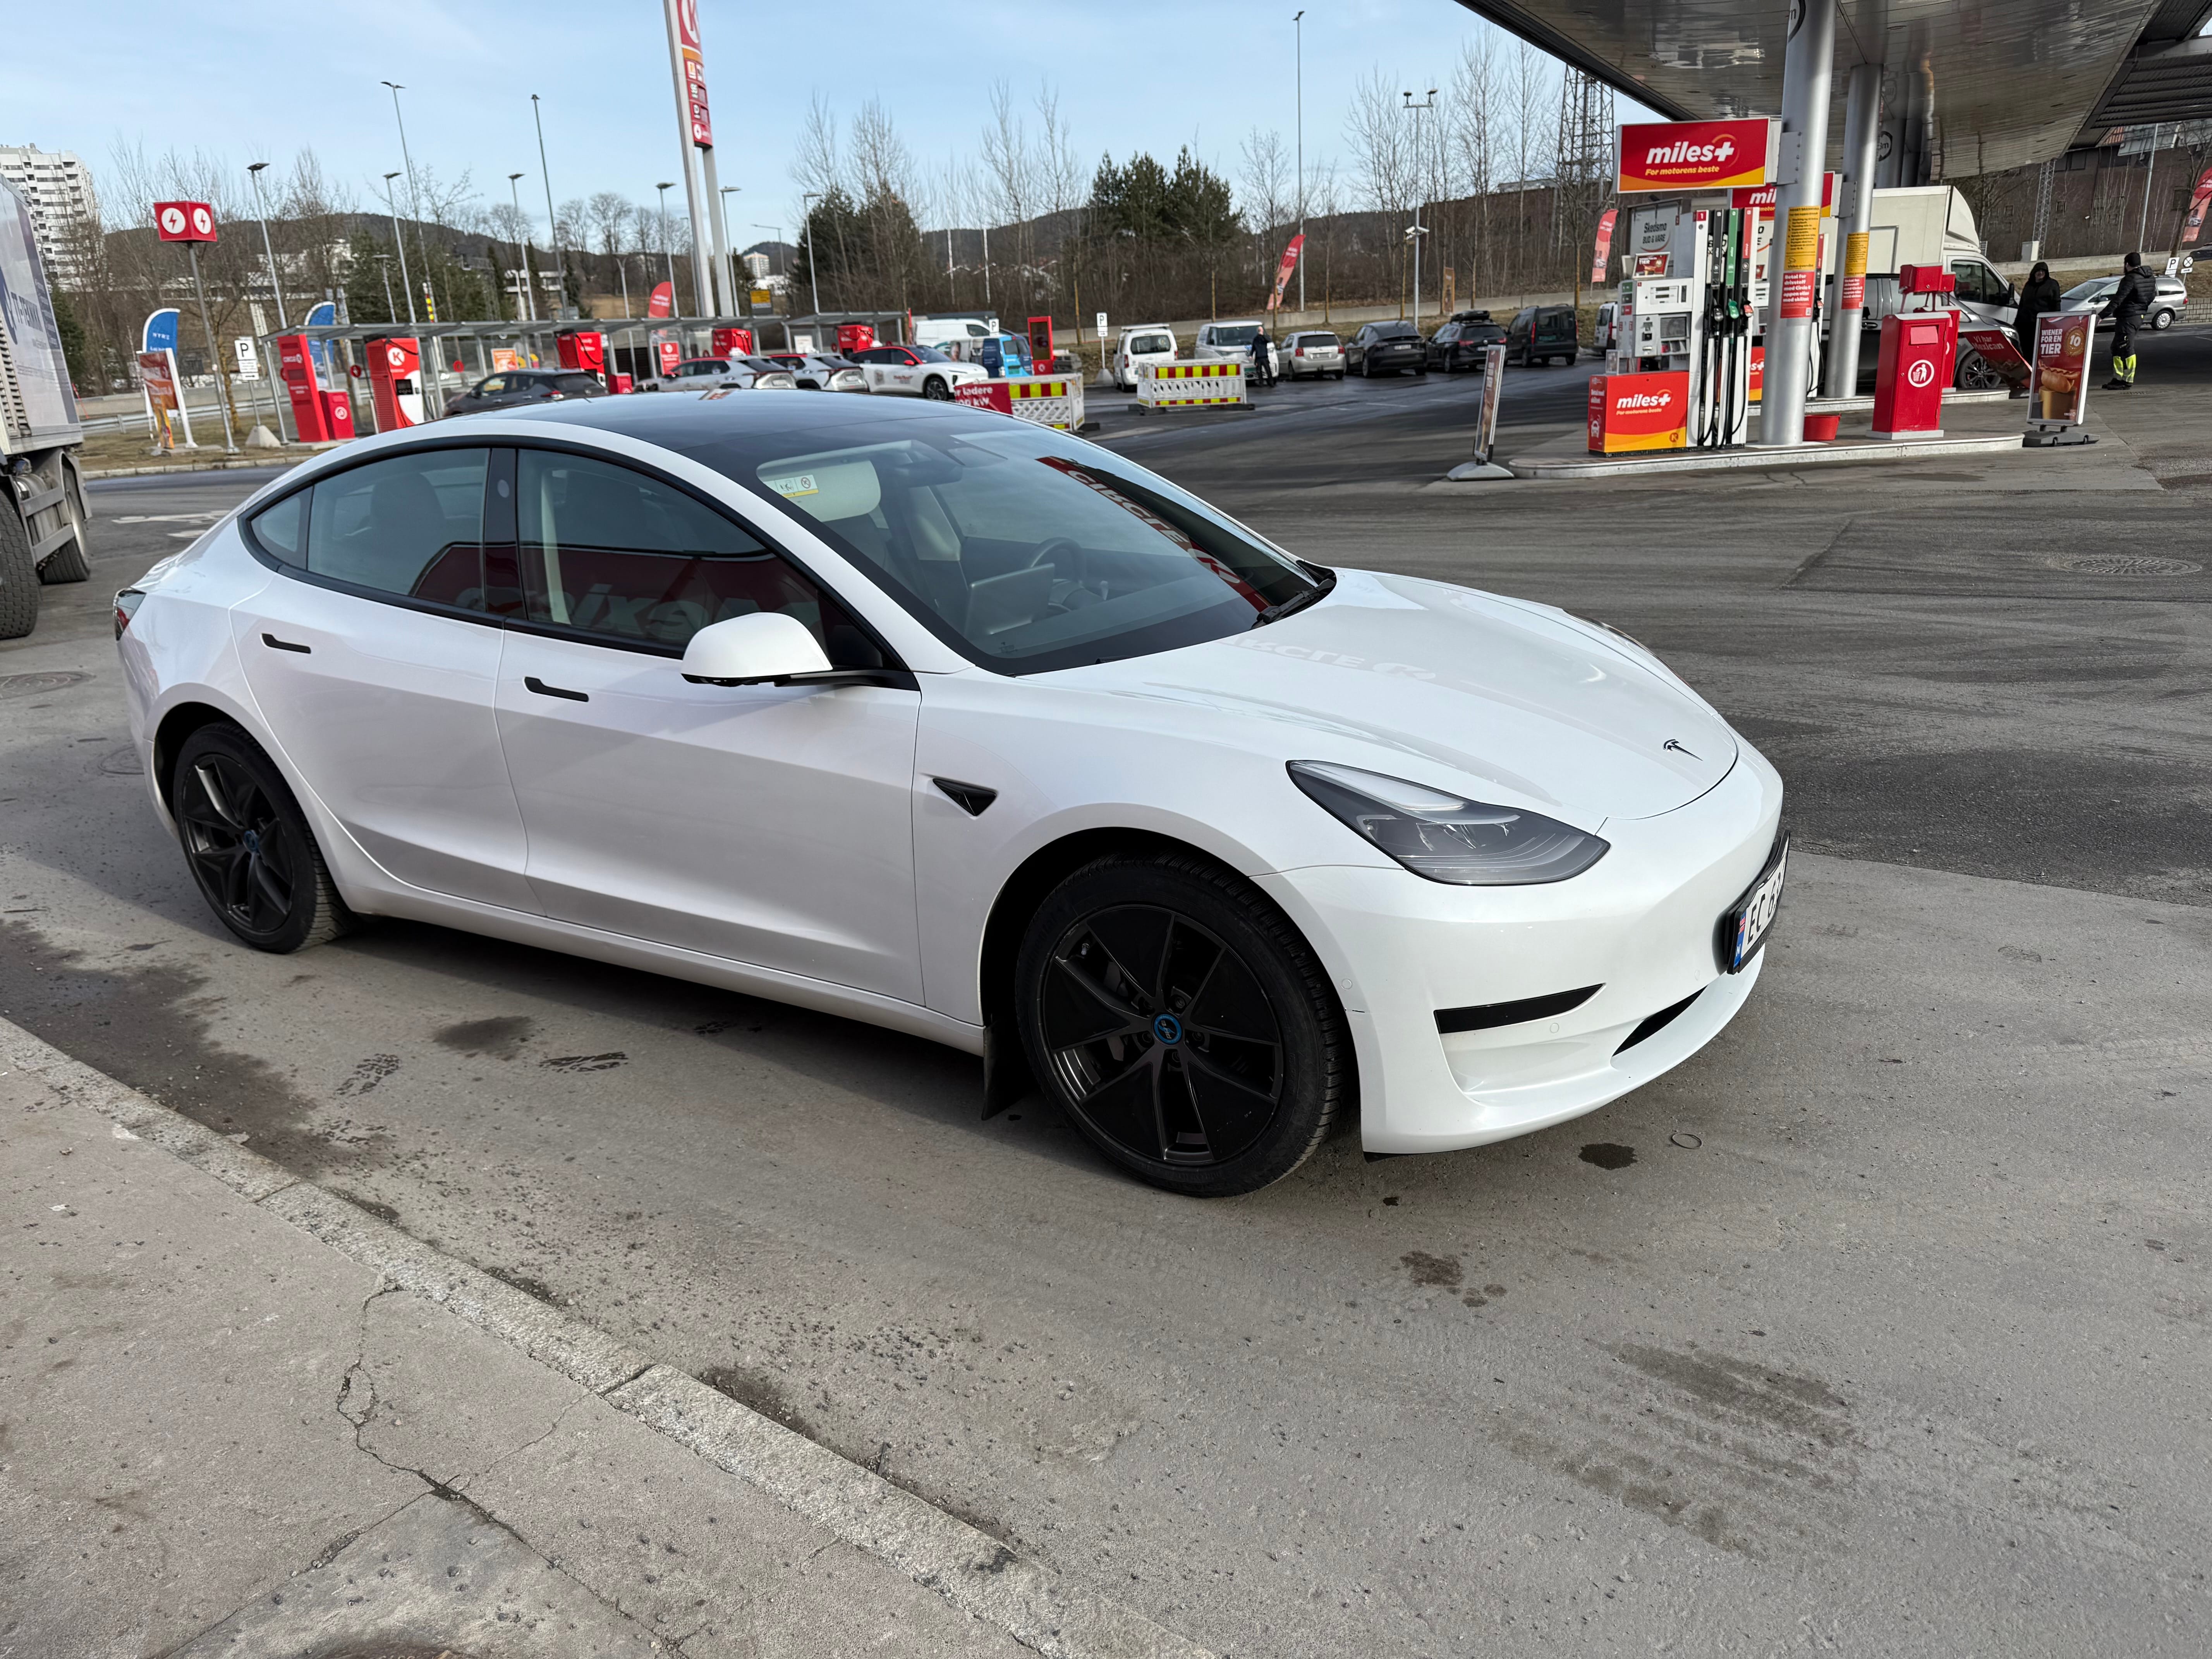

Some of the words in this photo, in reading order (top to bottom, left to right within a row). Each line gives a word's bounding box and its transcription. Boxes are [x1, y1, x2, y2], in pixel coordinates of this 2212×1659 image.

[1646, 141, 1735, 164] miles+
[1660, 167, 1697, 175] motorens
[1698, 165, 1720, 173] beste
[1749, 188, 1776, 204] mil
[2169, 259, 2176, 268] P
[2070, 335, 2081, 347] 10
[240, 343, 249, 357] P
[2040, 343, 2061, 354] TIER
[1616, 393, 1671, 409] miles+
[1747, 893, 1765, 945] EC
[1736, 944, 1741, 957] N
